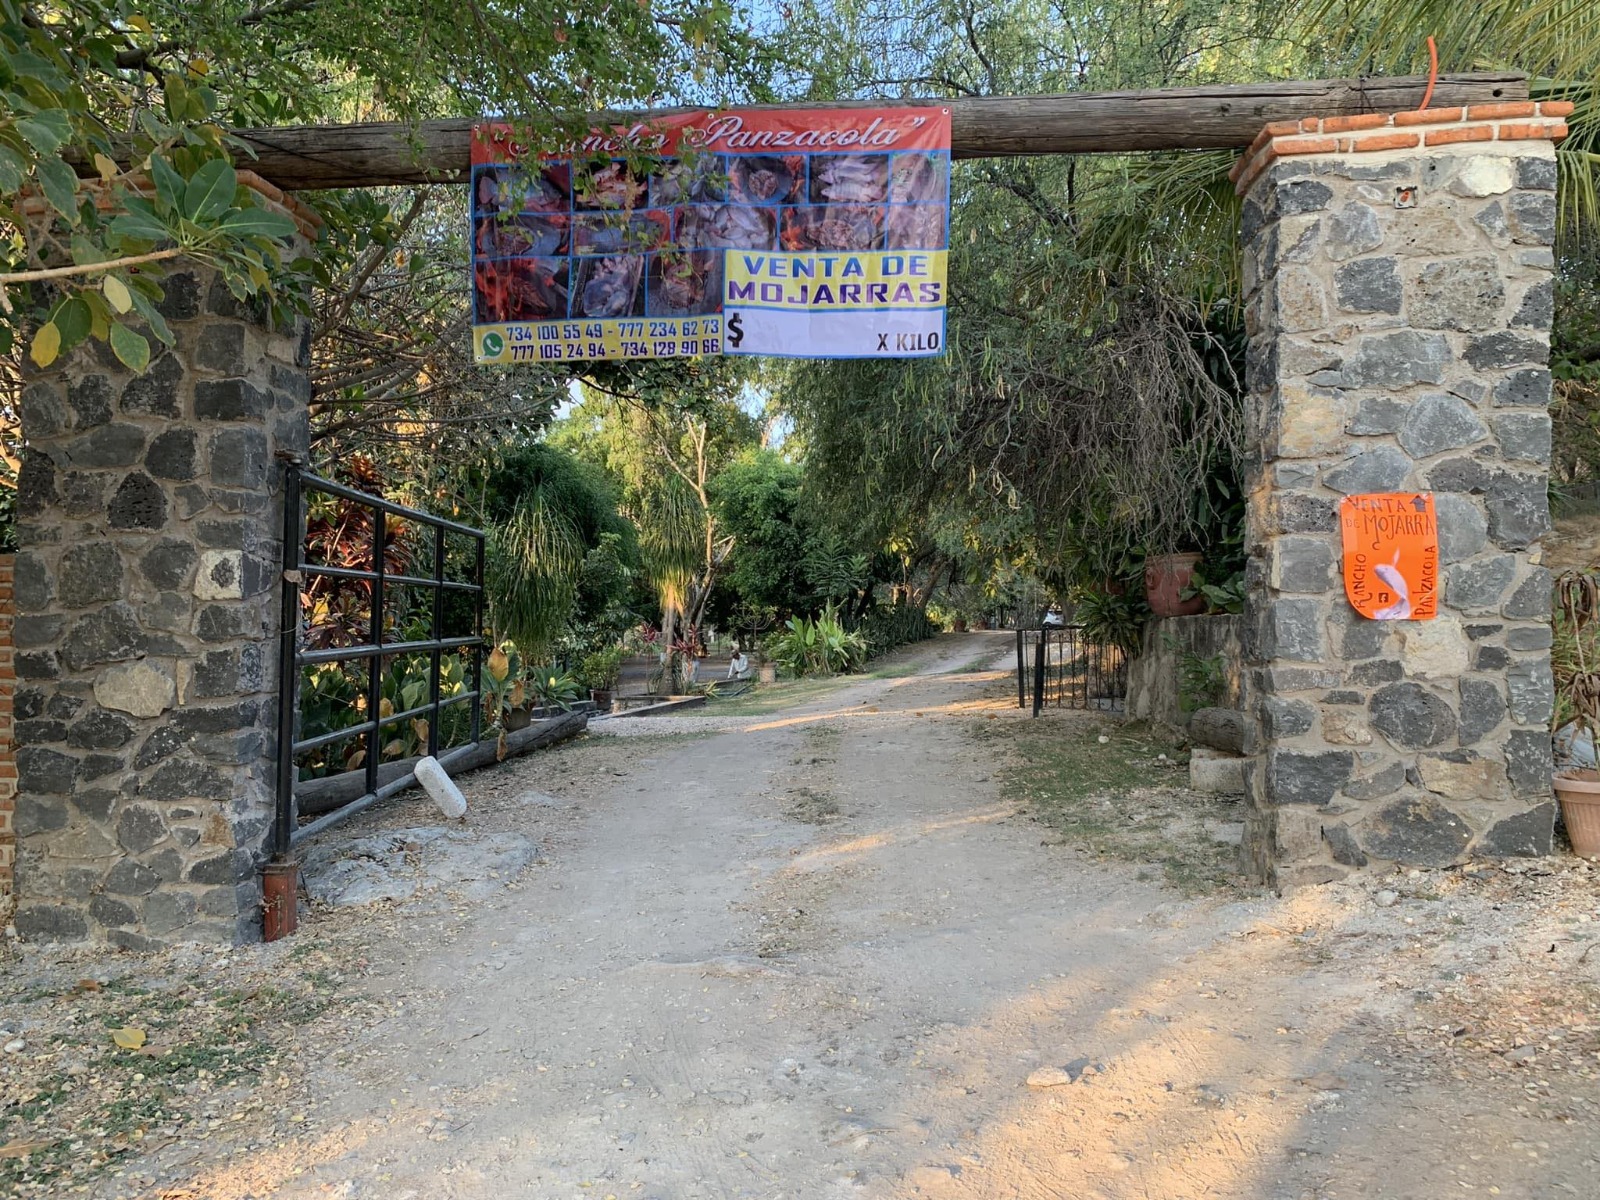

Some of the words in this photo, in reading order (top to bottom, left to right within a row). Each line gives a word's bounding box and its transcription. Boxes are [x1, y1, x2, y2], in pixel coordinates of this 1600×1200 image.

[743, 255, 864, 277] VENTA
[882, 255, 928, 276] DE
[728, 281, 941, 304] MOJARRAS
[506, 326, 532, 341] 734
[537, 325, 558, 341] 100
[563, 324, 580, 339] 55
[586, 323, 603, 339] 49
[618, 322, 643, 338] 777
[649, 321, 676, 337] 234
[682, 321, 697, 336] 62
[702, 320, 719, 335] 73
[727, 312, 744, 348] $
[511, 345, 534, 360] 777
[540, 344, 562, 359] 105
[567, 343, 583, 358] 24
[588, 343, 606, 358] 94
[620, 342, 648, 357] 734
[653, 341, 675, 356] 128
[681, 340, 697, 355] 90
[702, 339, 719, 354] 66
[876, 333, 888, 351] X
[896, 332, 939, 351] KILO
[1347, 497, 1406, 513] VENTA
[1363, 513, 1435, 540] MOJARRA
[1353, 553, 1373, 608] RANCHO
